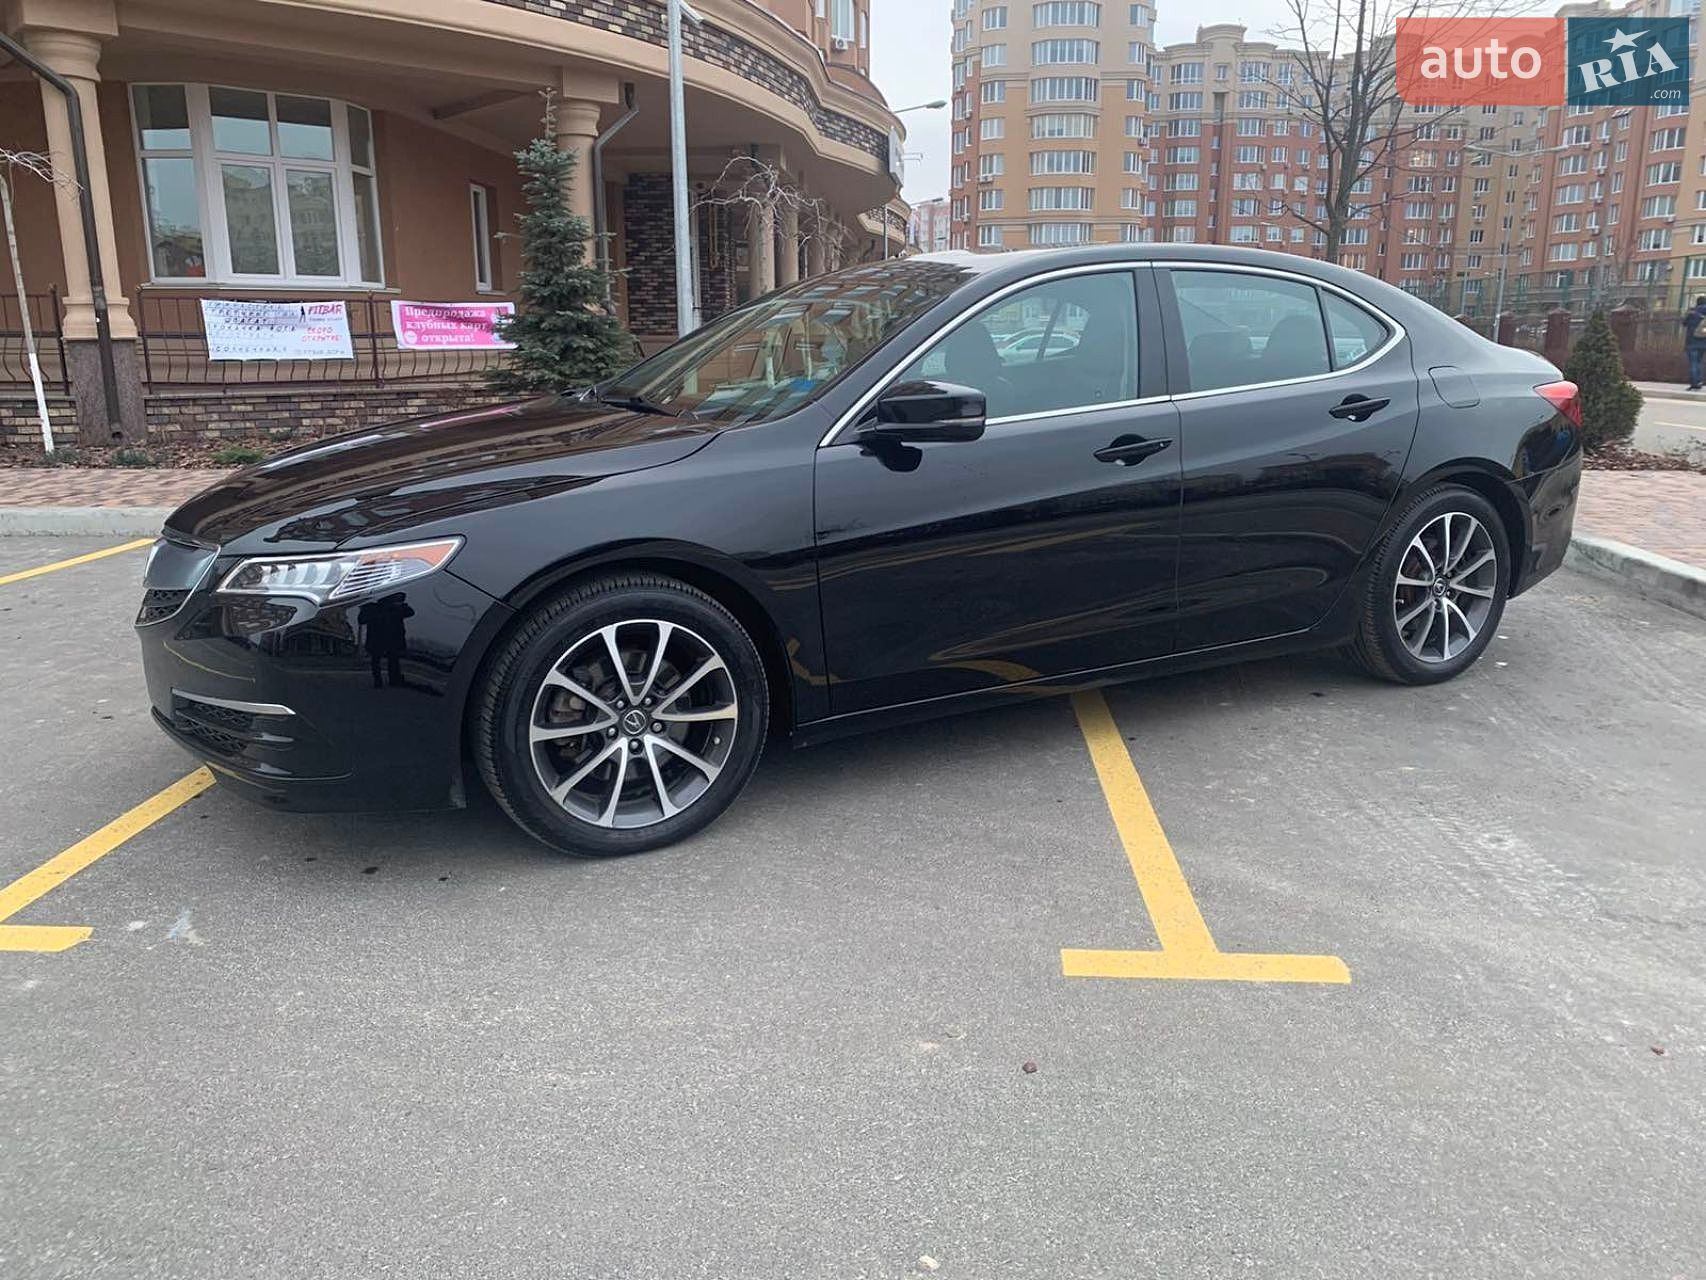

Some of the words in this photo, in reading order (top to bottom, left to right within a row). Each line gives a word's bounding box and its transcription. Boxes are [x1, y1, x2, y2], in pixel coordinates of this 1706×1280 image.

[405, 306, 486, 318] Предпродажа
[406, 319, 457, 332] клубных
[460, 321, 486, 332] карт
[421, 333, 475, 344] открыта!
